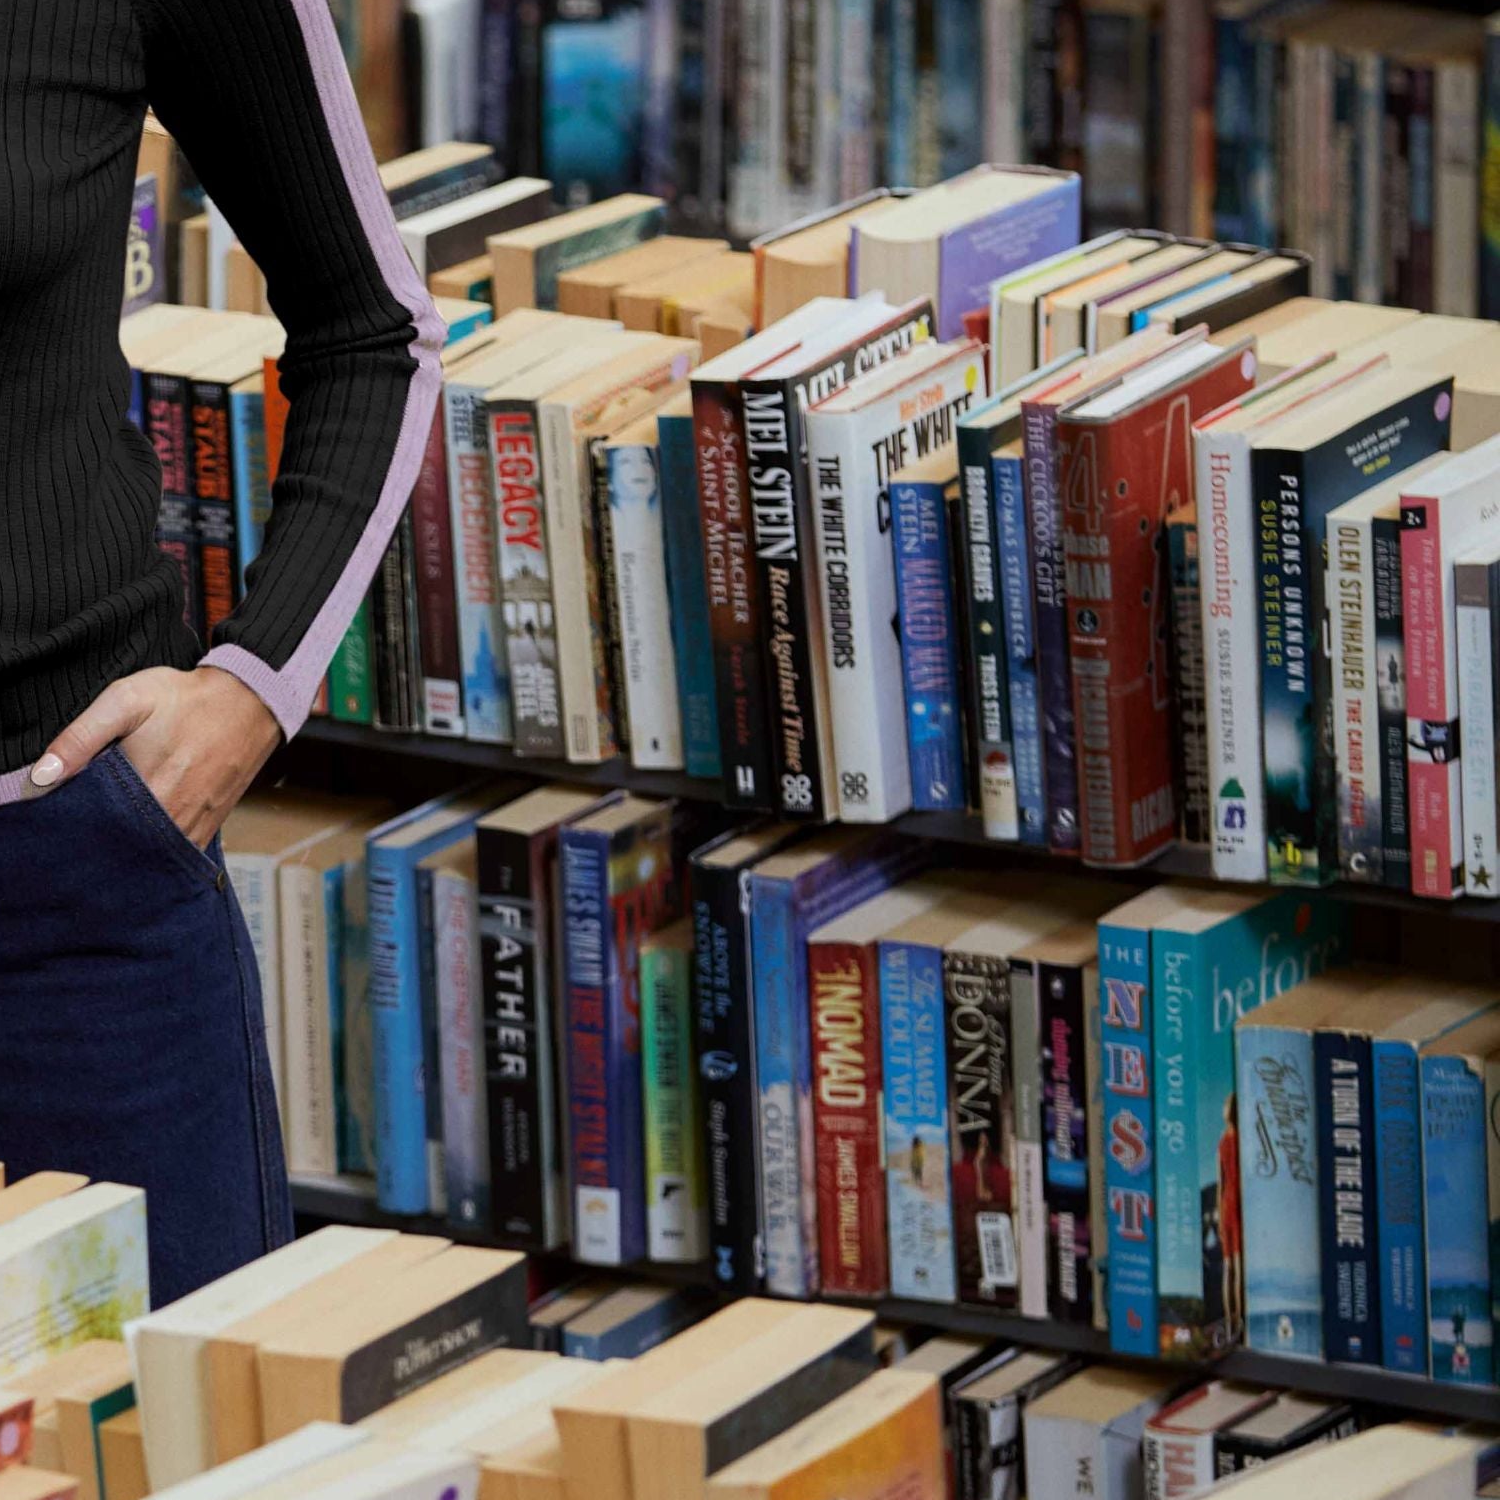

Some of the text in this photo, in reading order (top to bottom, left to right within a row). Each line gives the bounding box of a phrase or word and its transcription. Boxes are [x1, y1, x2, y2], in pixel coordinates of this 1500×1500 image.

[191, 405, 217, 498] STAUB
[451, 395, 496, 605] STEEL DECEMBER
[470, 394, 489, 449] JAMES
[490, 412, 558, 727] LEGACY JAMES
[742, 391, 806, 772] MEL STEIN Race Against Time
[817, 457, 854, 669] THE WHITE CORRIDORS
[898, 489, 947, 692] STEIN MARKED MAN
[919, 497, 937, 541] MEL
[999, 464, 1027, 659] THOMAS STEINBECK
[1027, 414, 1055, 606] THE CUCKOO'S GIFT
[1207, 453, 1236, 619] Homecoming
[1259, 500, 1282, 667] SUSIE STEINER
[1279, 474, 1305, 693] PERSONS UNKNOWN
[965, 465, 1002, 742] BROOKLYN GRAVES TRISS STEIN
[1337, 526, 1365, 829] OLEN STEINHAUER THE CAIRO AFFAIR
[513, 664, 539, 720] STEEL
[1071, 656, 1117, 860] RICHARD STEINBERG
[1217, 628, 1237, 764] SUSIE STEINER
[492, 902, 529, 1080] FATHER
[950, 973, 992, 1135] DONNA
[986, 1015, 1006, 1097] Prima
[1156, 951, 1193, 1155] before you go
[1331, 1059, 1359, 1073] A
[815, 984, 866, 1268] NOMAD JAMES SWALLOW
[1101, 944, 1154, 1241] THE NEST
[1331, 1077, 1360, 1125] TURN
[1334, 1128, 1361, 1153] OF
[1335, 1156, 1362, 1190] THE
[1336, 1191, 1364, 1248] BLADE
[1337, 1261, 1351, 1319] SWEENEY
